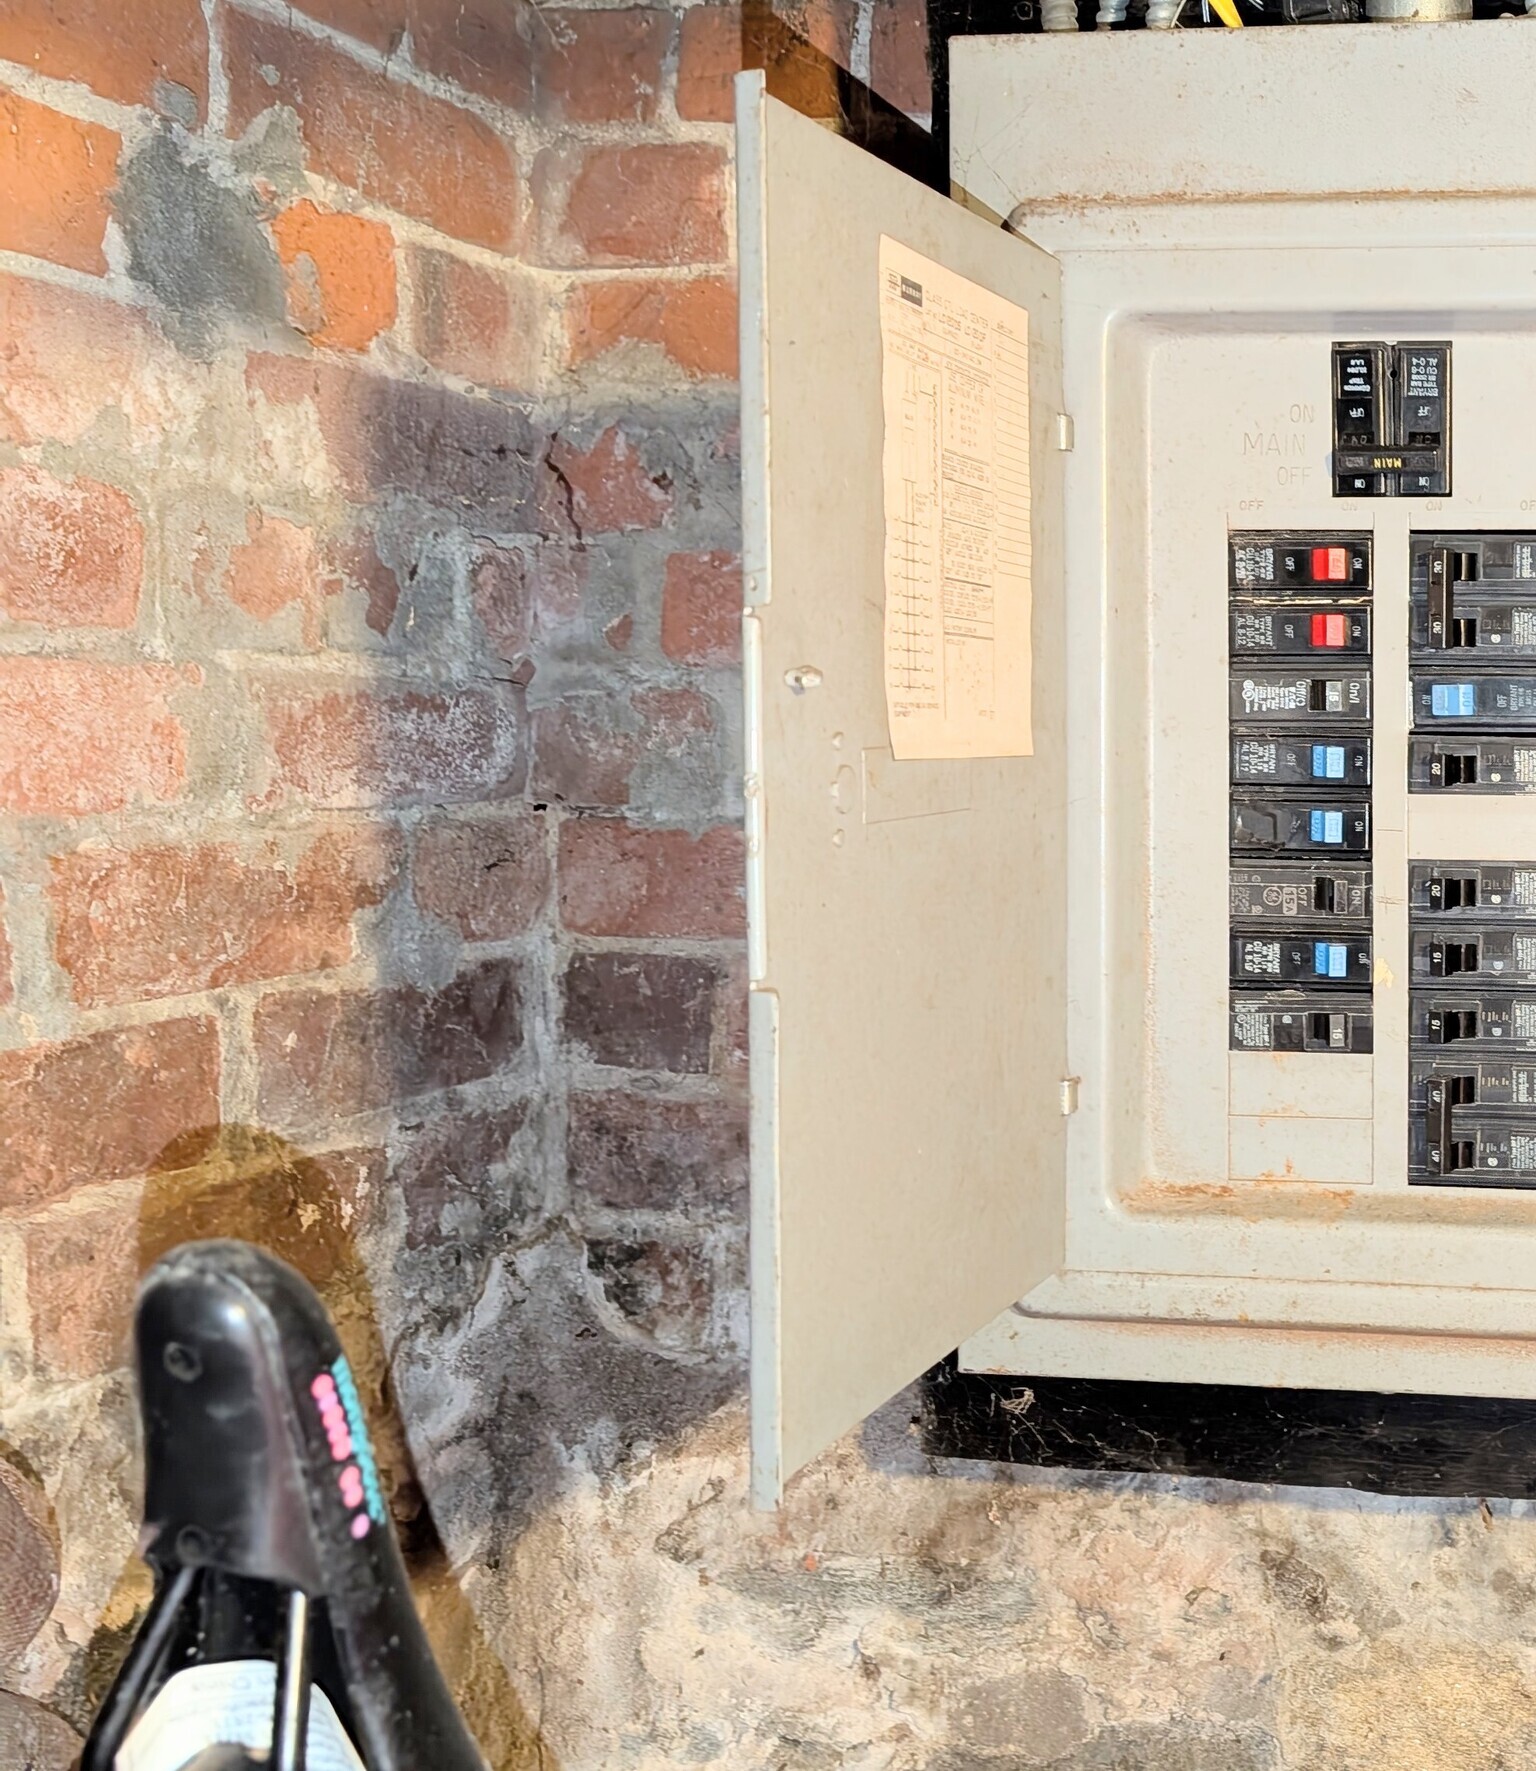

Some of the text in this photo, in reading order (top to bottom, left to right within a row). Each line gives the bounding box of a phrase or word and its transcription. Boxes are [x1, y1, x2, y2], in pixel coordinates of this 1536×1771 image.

[1290, 404, 1314, 423] ON
[1243, 432, 1305, 456] MAIN
[1373, 457, 1402, 469] MAIN
[1277, 466, 1313, 486] OFF
[1239, 500, 1264, 511] OFF
[1285, 557, 1295, 571] OFF
[1352, 557, 1363, 570] ON
[1434, 561, 1443, 574] 30
[1237, 617, 1246, 627] AL
[1433, 621, 1442, 634] 30
[1246, 616, 1255, 647] CU 10-14
[1265, 616, 1273, 646] BRYANT
[1284, 624, 1294, 639] OFF
[1352, 626, 1361, 637] ON
[1422, 694, 1431, 705] ON
[1497, 695, 1507, 708] OFF
[1509, 684, 1518, 711] BRYANT
[1432, 763, 1441, 775] 20
[1354, 821, 1364, 832] ON
[1298, 888, 1307, 907] OFF
[1351, 889, 1361, 905] ON
[1432, 885, 1440, 897] 20
[1285, 890, 1295, 913] 15A
